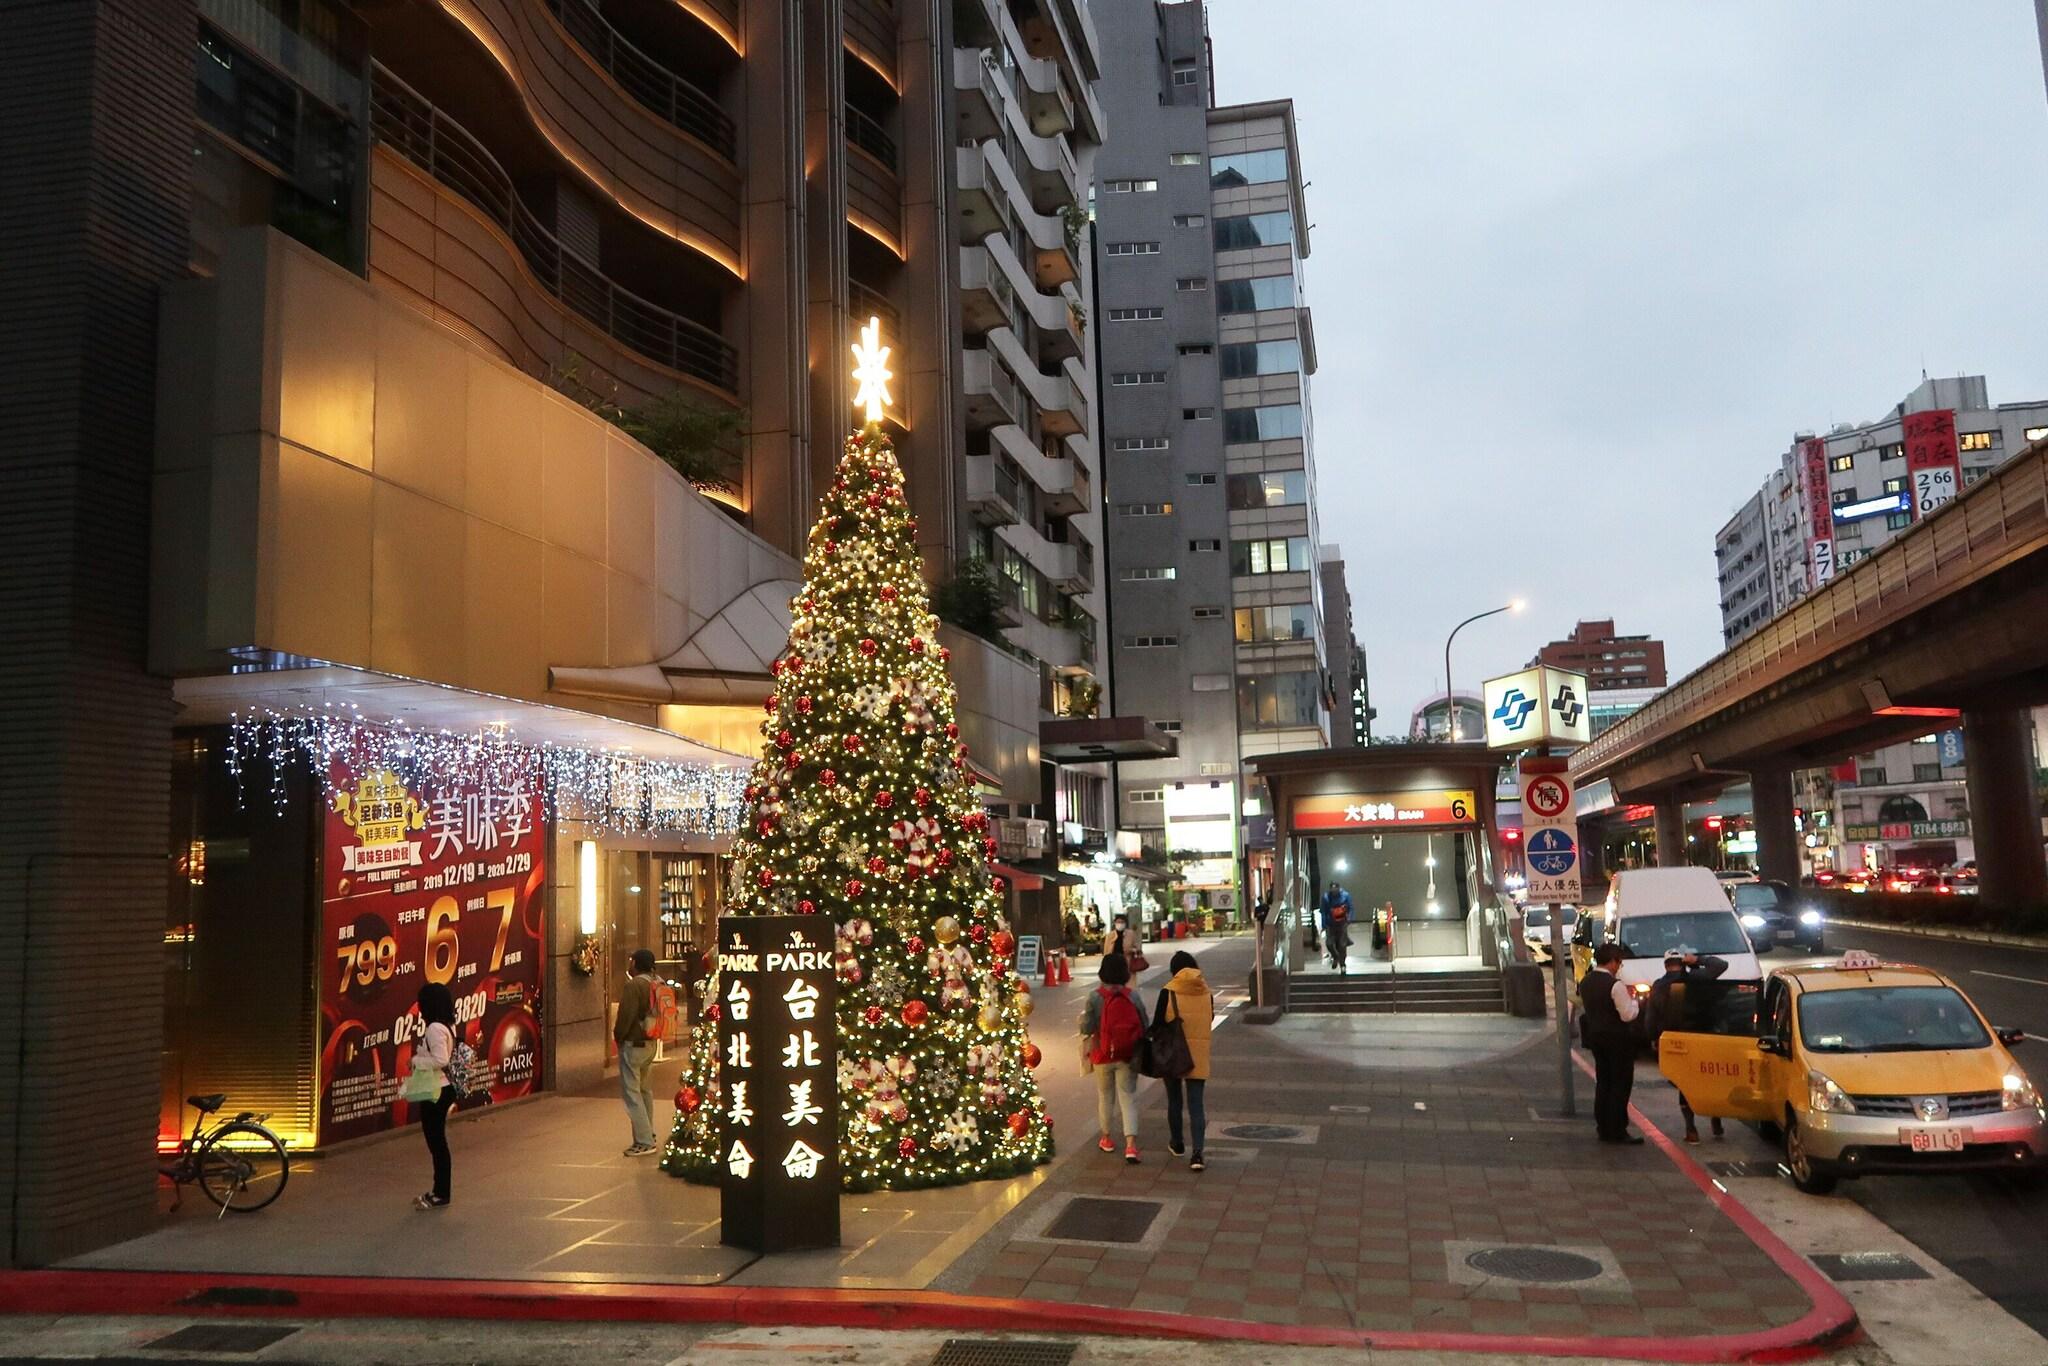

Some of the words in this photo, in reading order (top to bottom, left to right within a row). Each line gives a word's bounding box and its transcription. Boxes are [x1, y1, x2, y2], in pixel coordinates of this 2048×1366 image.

[1815, 542, 1830, 582] 27
[1537, 786, 1560, 807] 停
[429, 779, 532, 860] 美味季
[1452, 799, 1467, 819] 6
[357, 846, 409, 865] 美味全自助餐
[367, 871, 381, 883] FULL
[424, 874, 443, 890] 2019
[443, 862, 475, 886] 12/19
[487, 863, 505, 878] 2020
[506, 852, 531, 875] 2/29
[1530, 879, 1580, 892] 行人優先
[424, 895, 460, 984] 6
[487, 887, 516, 973] 7
[337, 935, 397, 993] 799
[719, 954, 759, 972] PARK
[766, 951, 833, 972] PARK
[1843, 959, 1875, 968] TAXI
[503, 1052, 534, 1073] PARK
[727, 979, 754, 1180] 台北美侖
[782, 977, 825, 1180] 台北美侖
